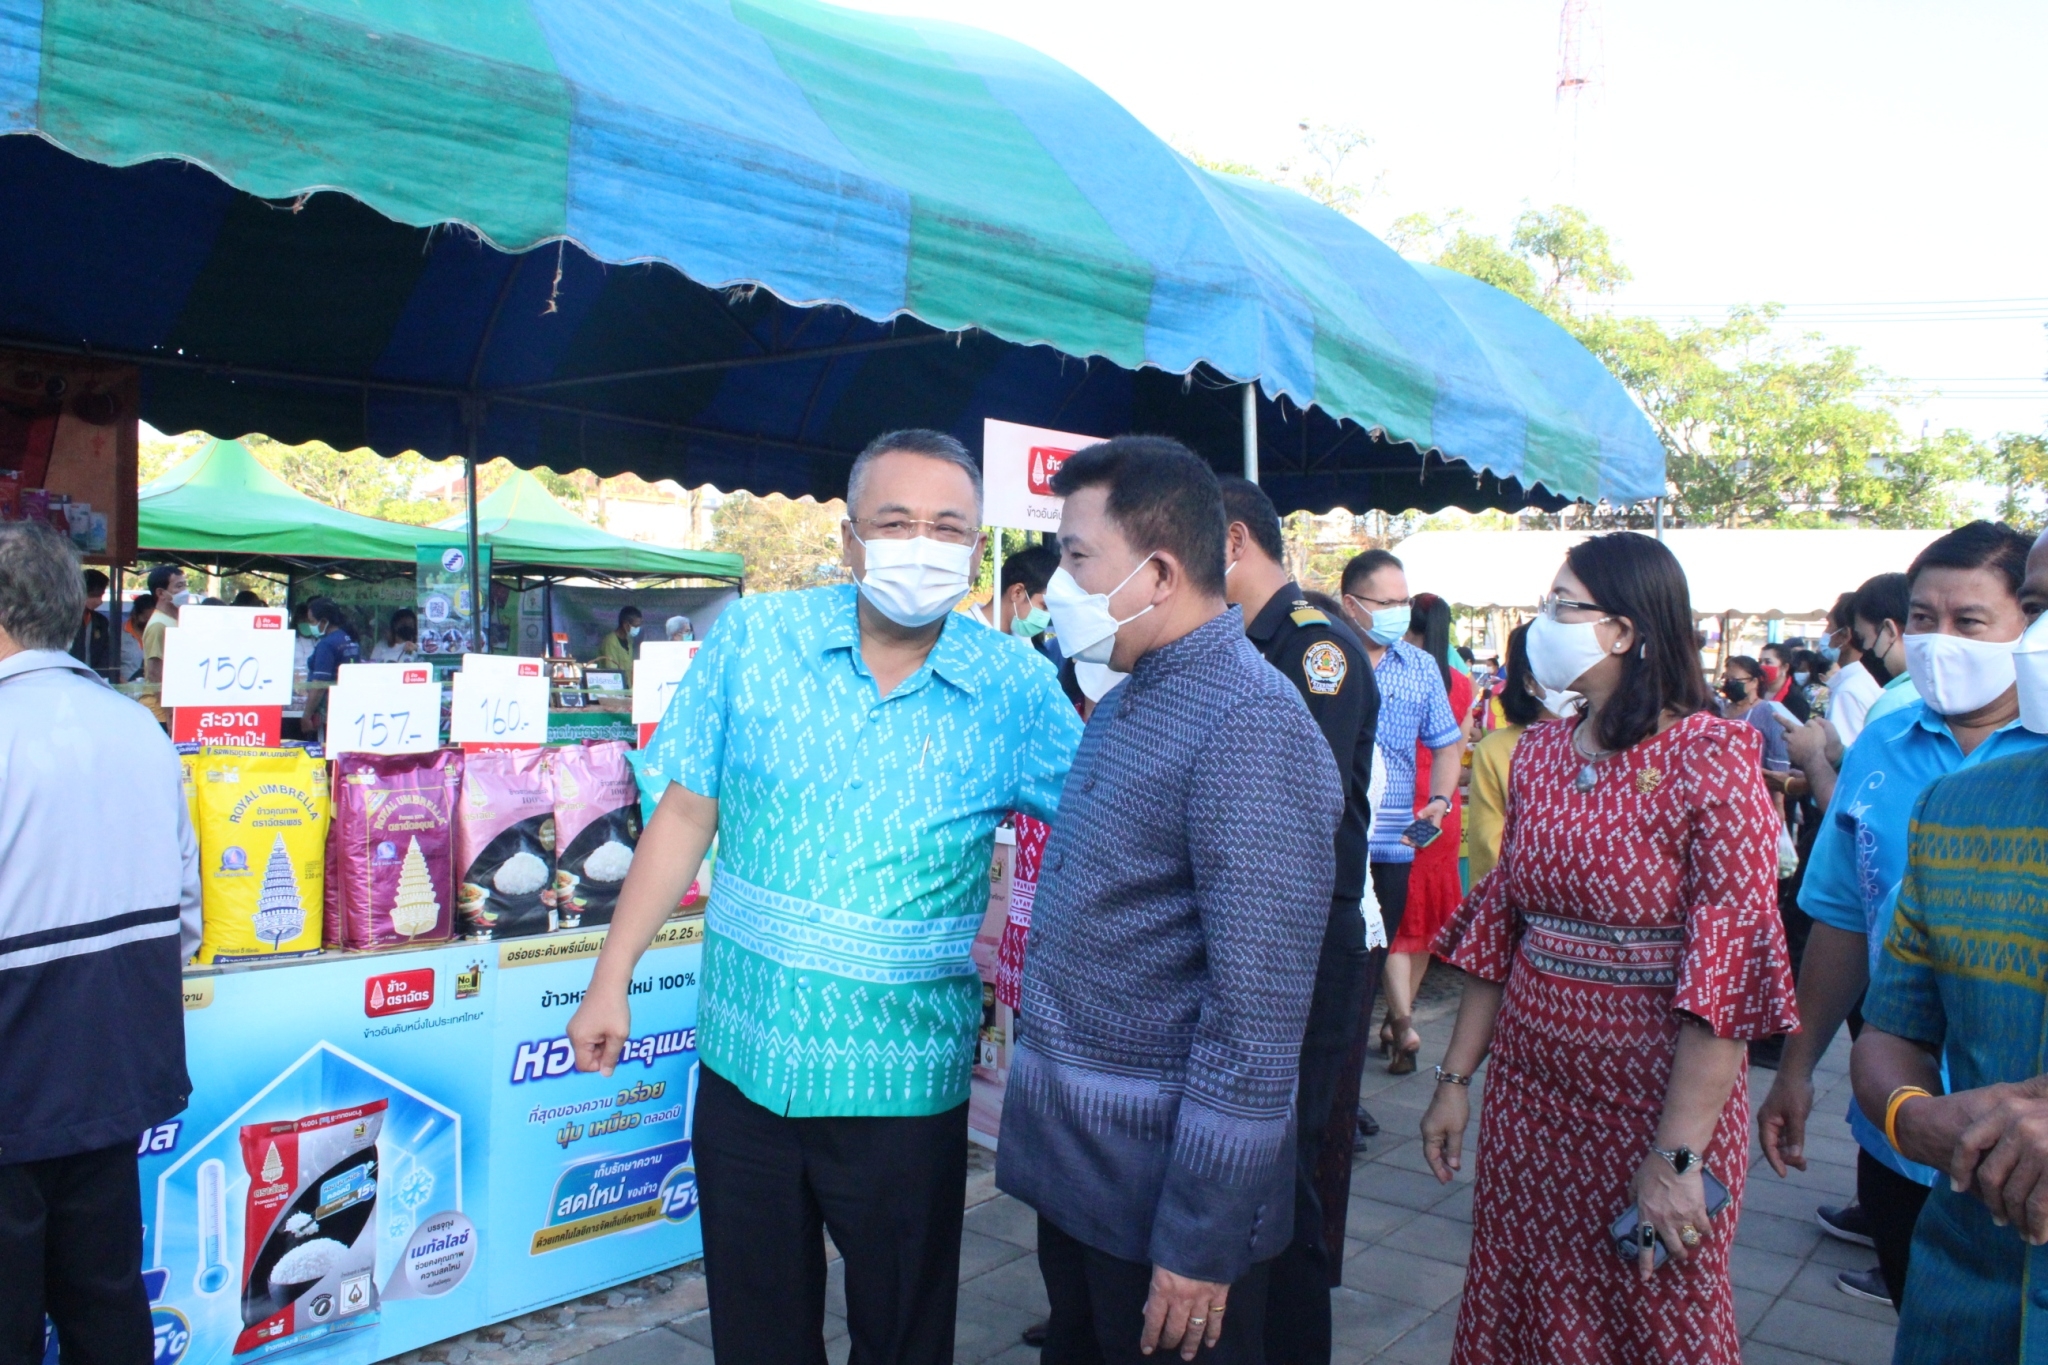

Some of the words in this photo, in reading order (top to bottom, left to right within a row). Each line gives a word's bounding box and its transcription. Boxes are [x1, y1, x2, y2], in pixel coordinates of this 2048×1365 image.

[199, 656, 272, 691] 150.-
[200, 711, 258, 728] สะอาด
[354, 711, 421, 748] 157.-
[481, 697, 529, 735] 160.-
[229, 790, 259, 824] ROYAL
[259, 784, 320, 821] UMBRELLA
[257, 807, 298, 817] ข้าวคุณภาพ
[374, 800, 398, 830] ROYAL
[396, 794, 447, 826] UMBRELLA
[669, 927, 693, 941] 2.25
[387, 980, 407, 993] ข้าว
[387, 990, 430, 1006] ตราฉัตร
[541, 990, 587, 1008] ข้าวหอ
[659, 972, 696, 991] 100%
[528, 1096, 613, 1125] ที่สุดของความ
[615, 1080, 666, 1107] อร่อย
[556, 1120, 584, 1150] นุ่ม
[588, 1111, 641, 1137] เหนียว
[643, 1105, 681, 1125] ตลอดปี
[594, 1153, 663, 1179] เก็บรักษาความ
[557, 1176, 627, 1217] สดใหม่
[627, 1182, 658, 1199] ของข้าว
[420, 1261, 462, 1281] ความสดใหม่
